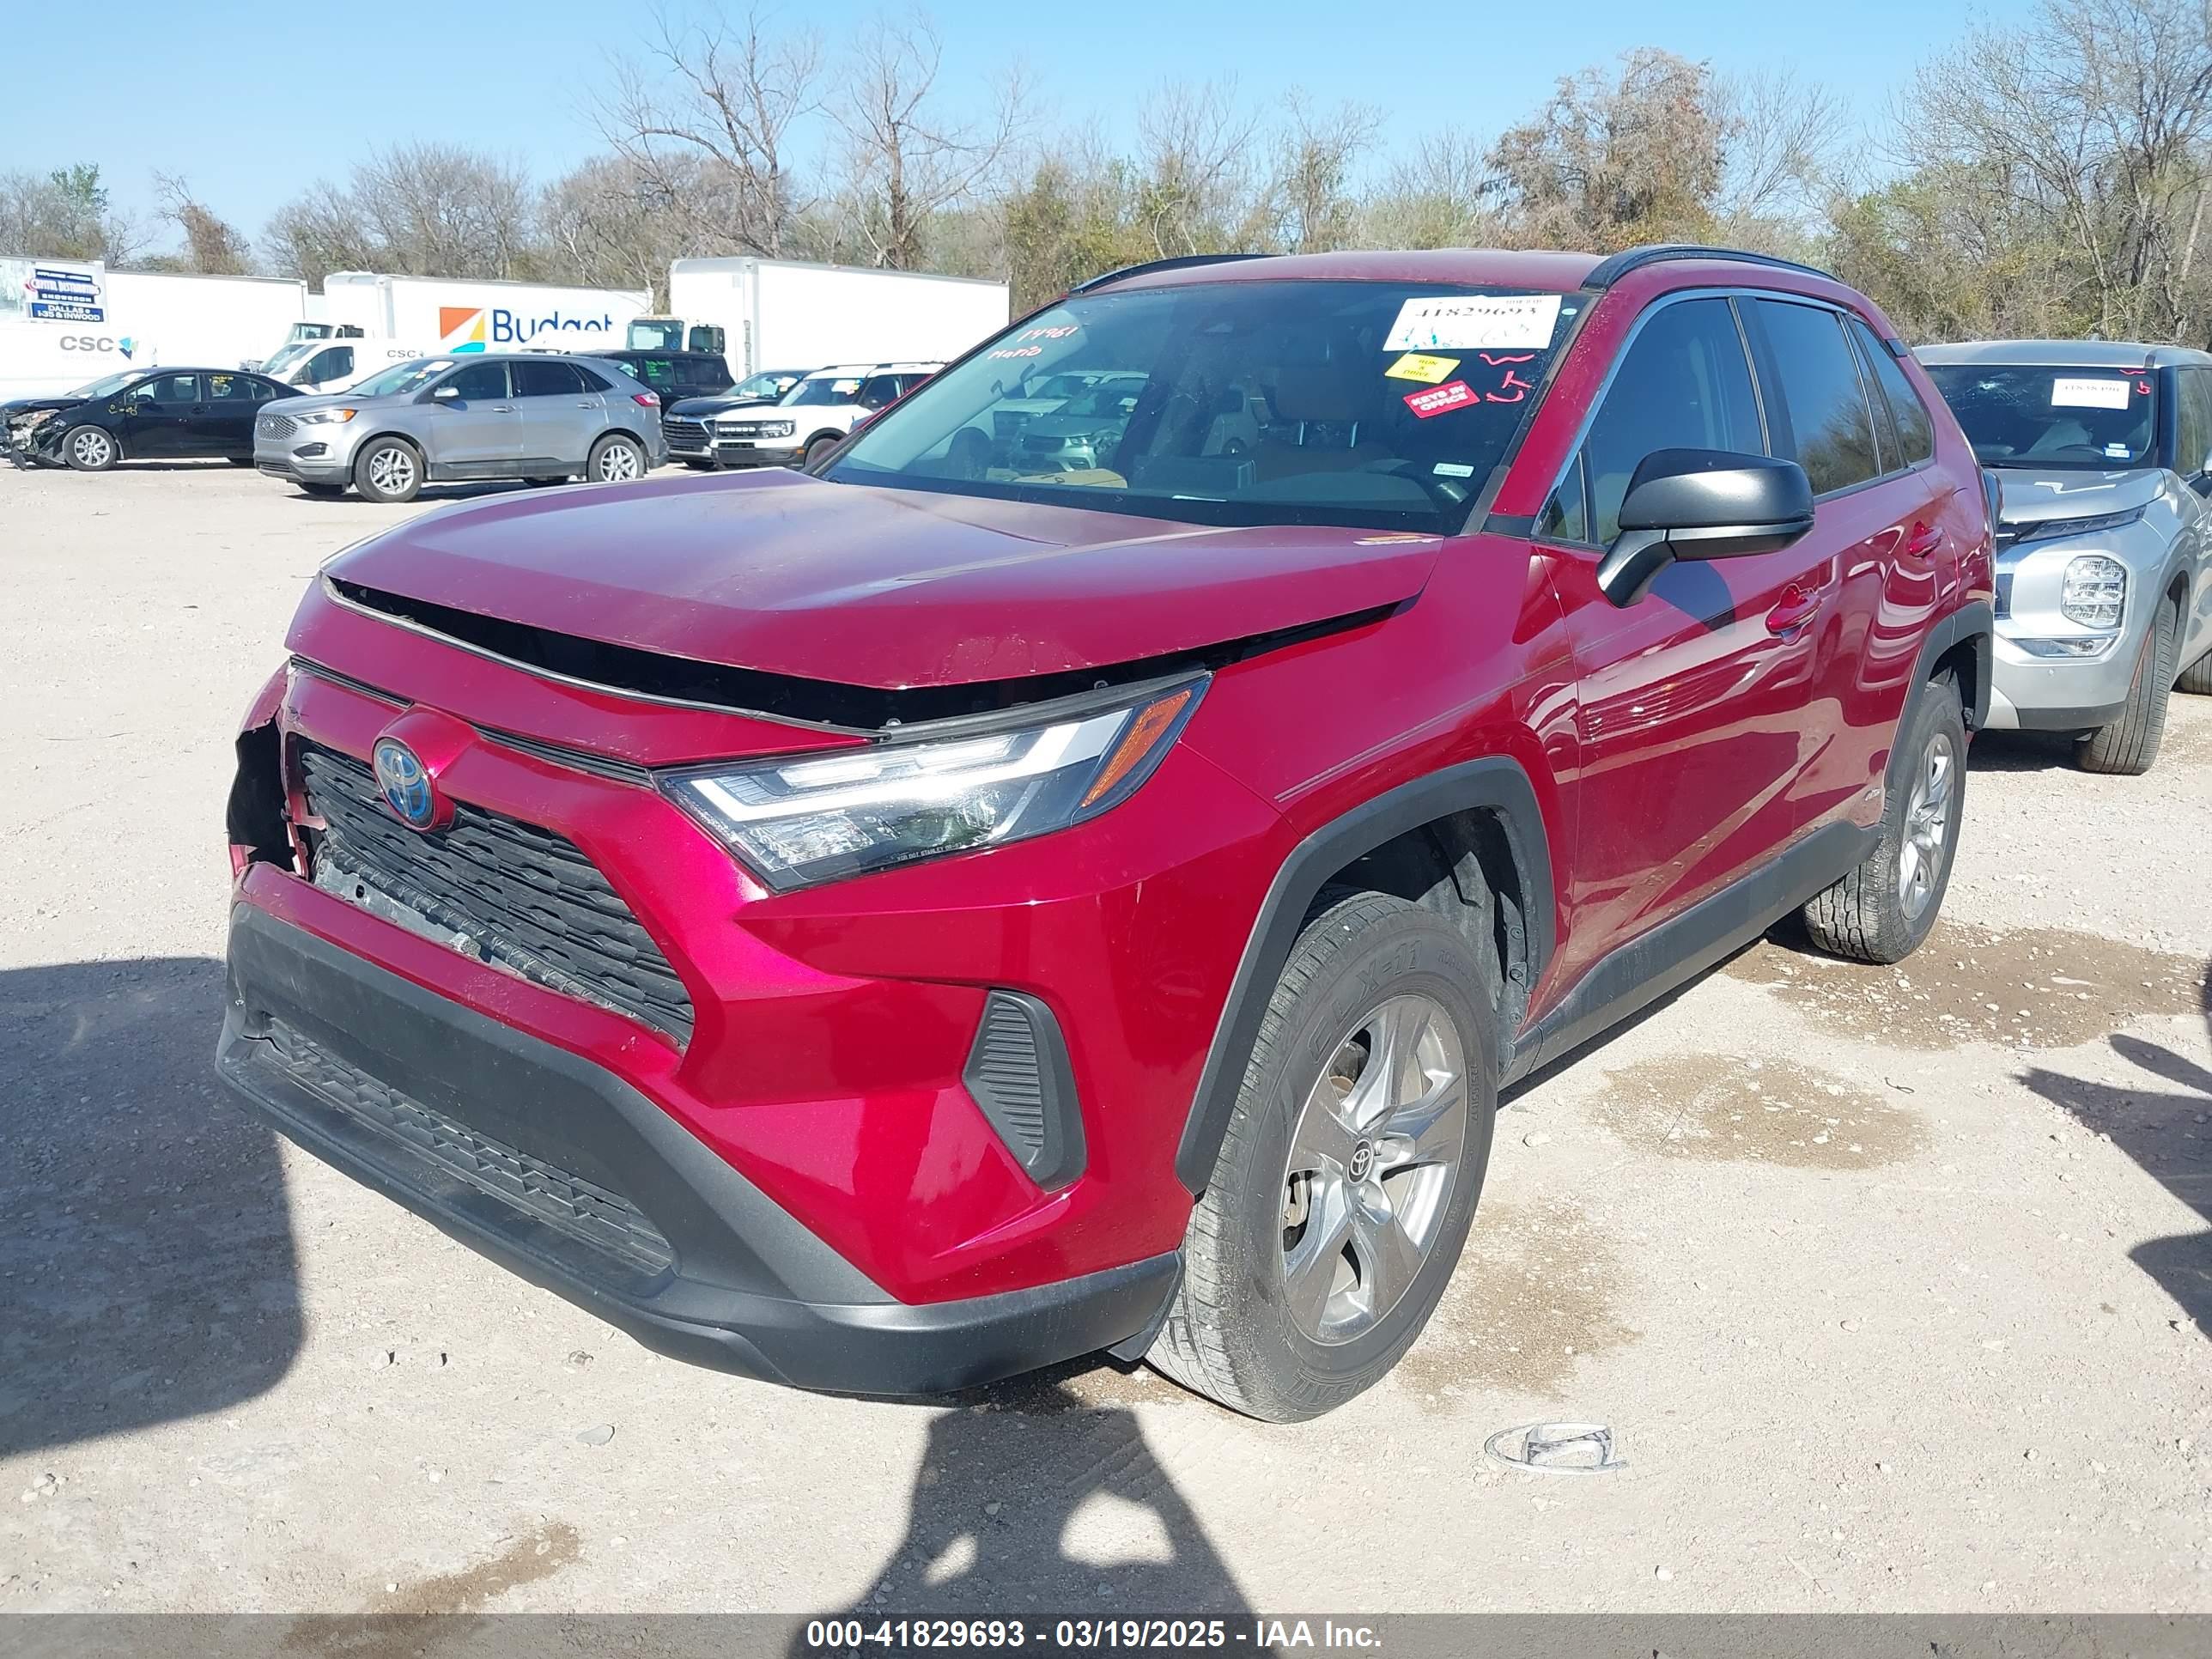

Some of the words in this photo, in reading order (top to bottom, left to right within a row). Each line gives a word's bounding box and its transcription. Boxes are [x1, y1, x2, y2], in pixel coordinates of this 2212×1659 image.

[37, 309, 55, 319] I-35
[64, 312, 100, 321] INWOOD
[47, 305, 84, 314] DALLAS
[1415, 307, 1537, 318] 41829693
[59, 336, 114, 352] CSC
[386, 349, 416, 358] CSC
[1411, 390, 1448, 406] KEYS
[1419, 392, 1469, 411] OFFICE
